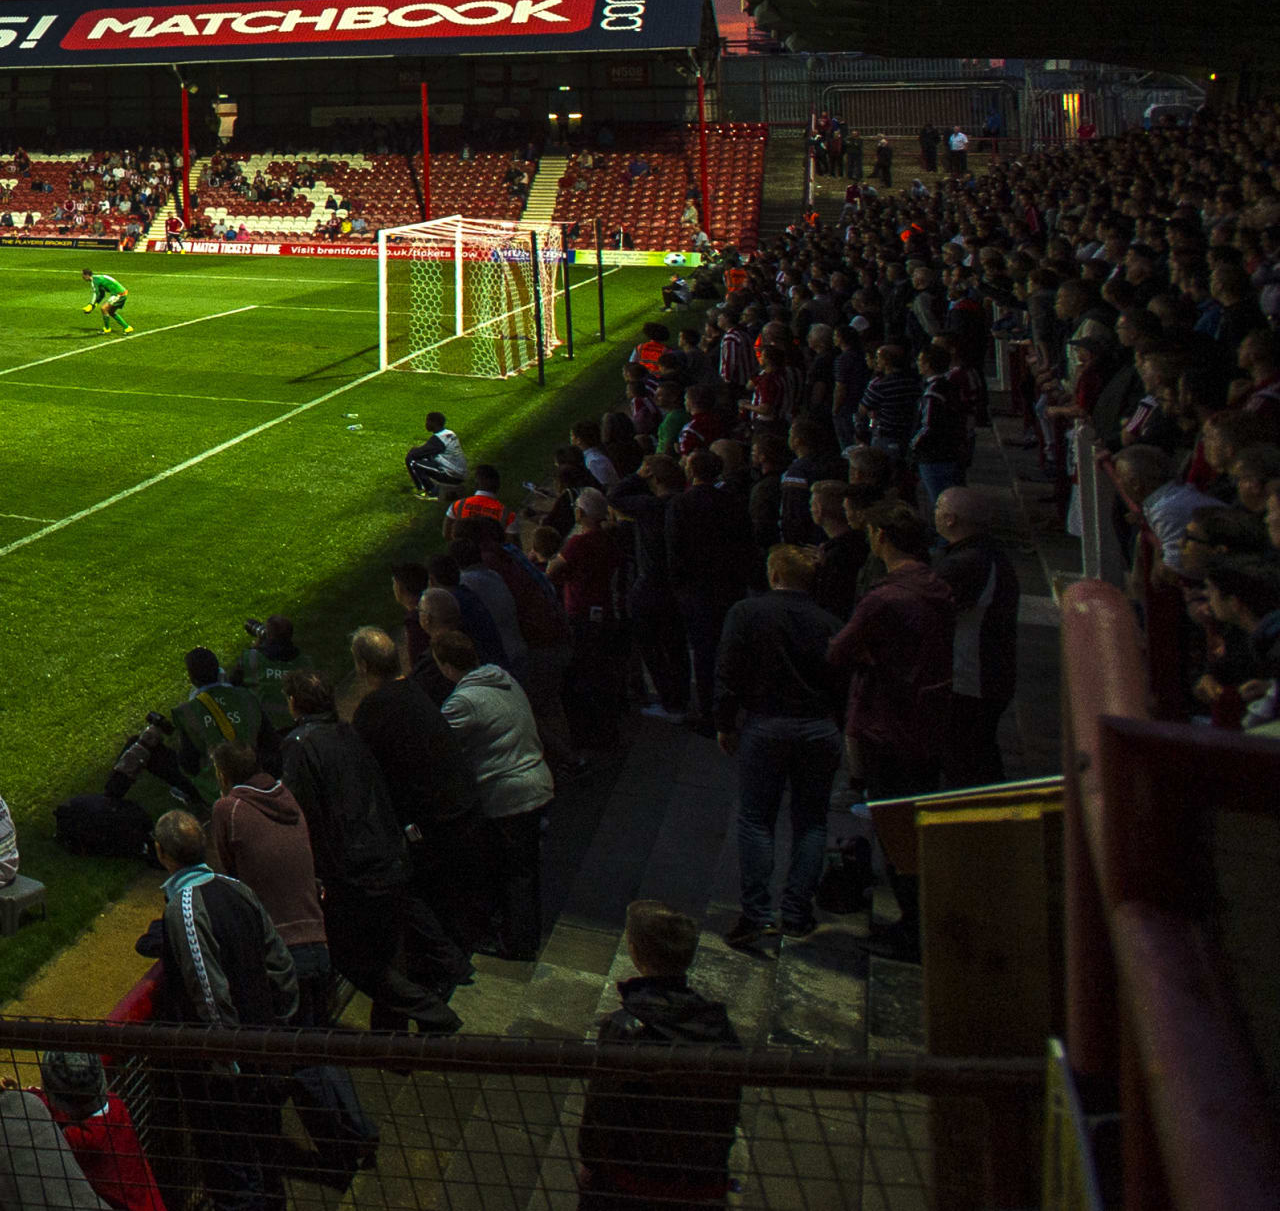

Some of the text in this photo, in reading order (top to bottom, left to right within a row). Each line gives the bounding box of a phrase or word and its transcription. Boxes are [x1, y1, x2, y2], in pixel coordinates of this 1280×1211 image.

[192, 241, 220, 254] MATCH
[220, 242, 252, 254] TICKETS
[252, 243, 281, 255] ONLINE
[291, 245, 315, 255] Visit
[317, 246, 451, 259] brentfordfc.o.uk/tickets
